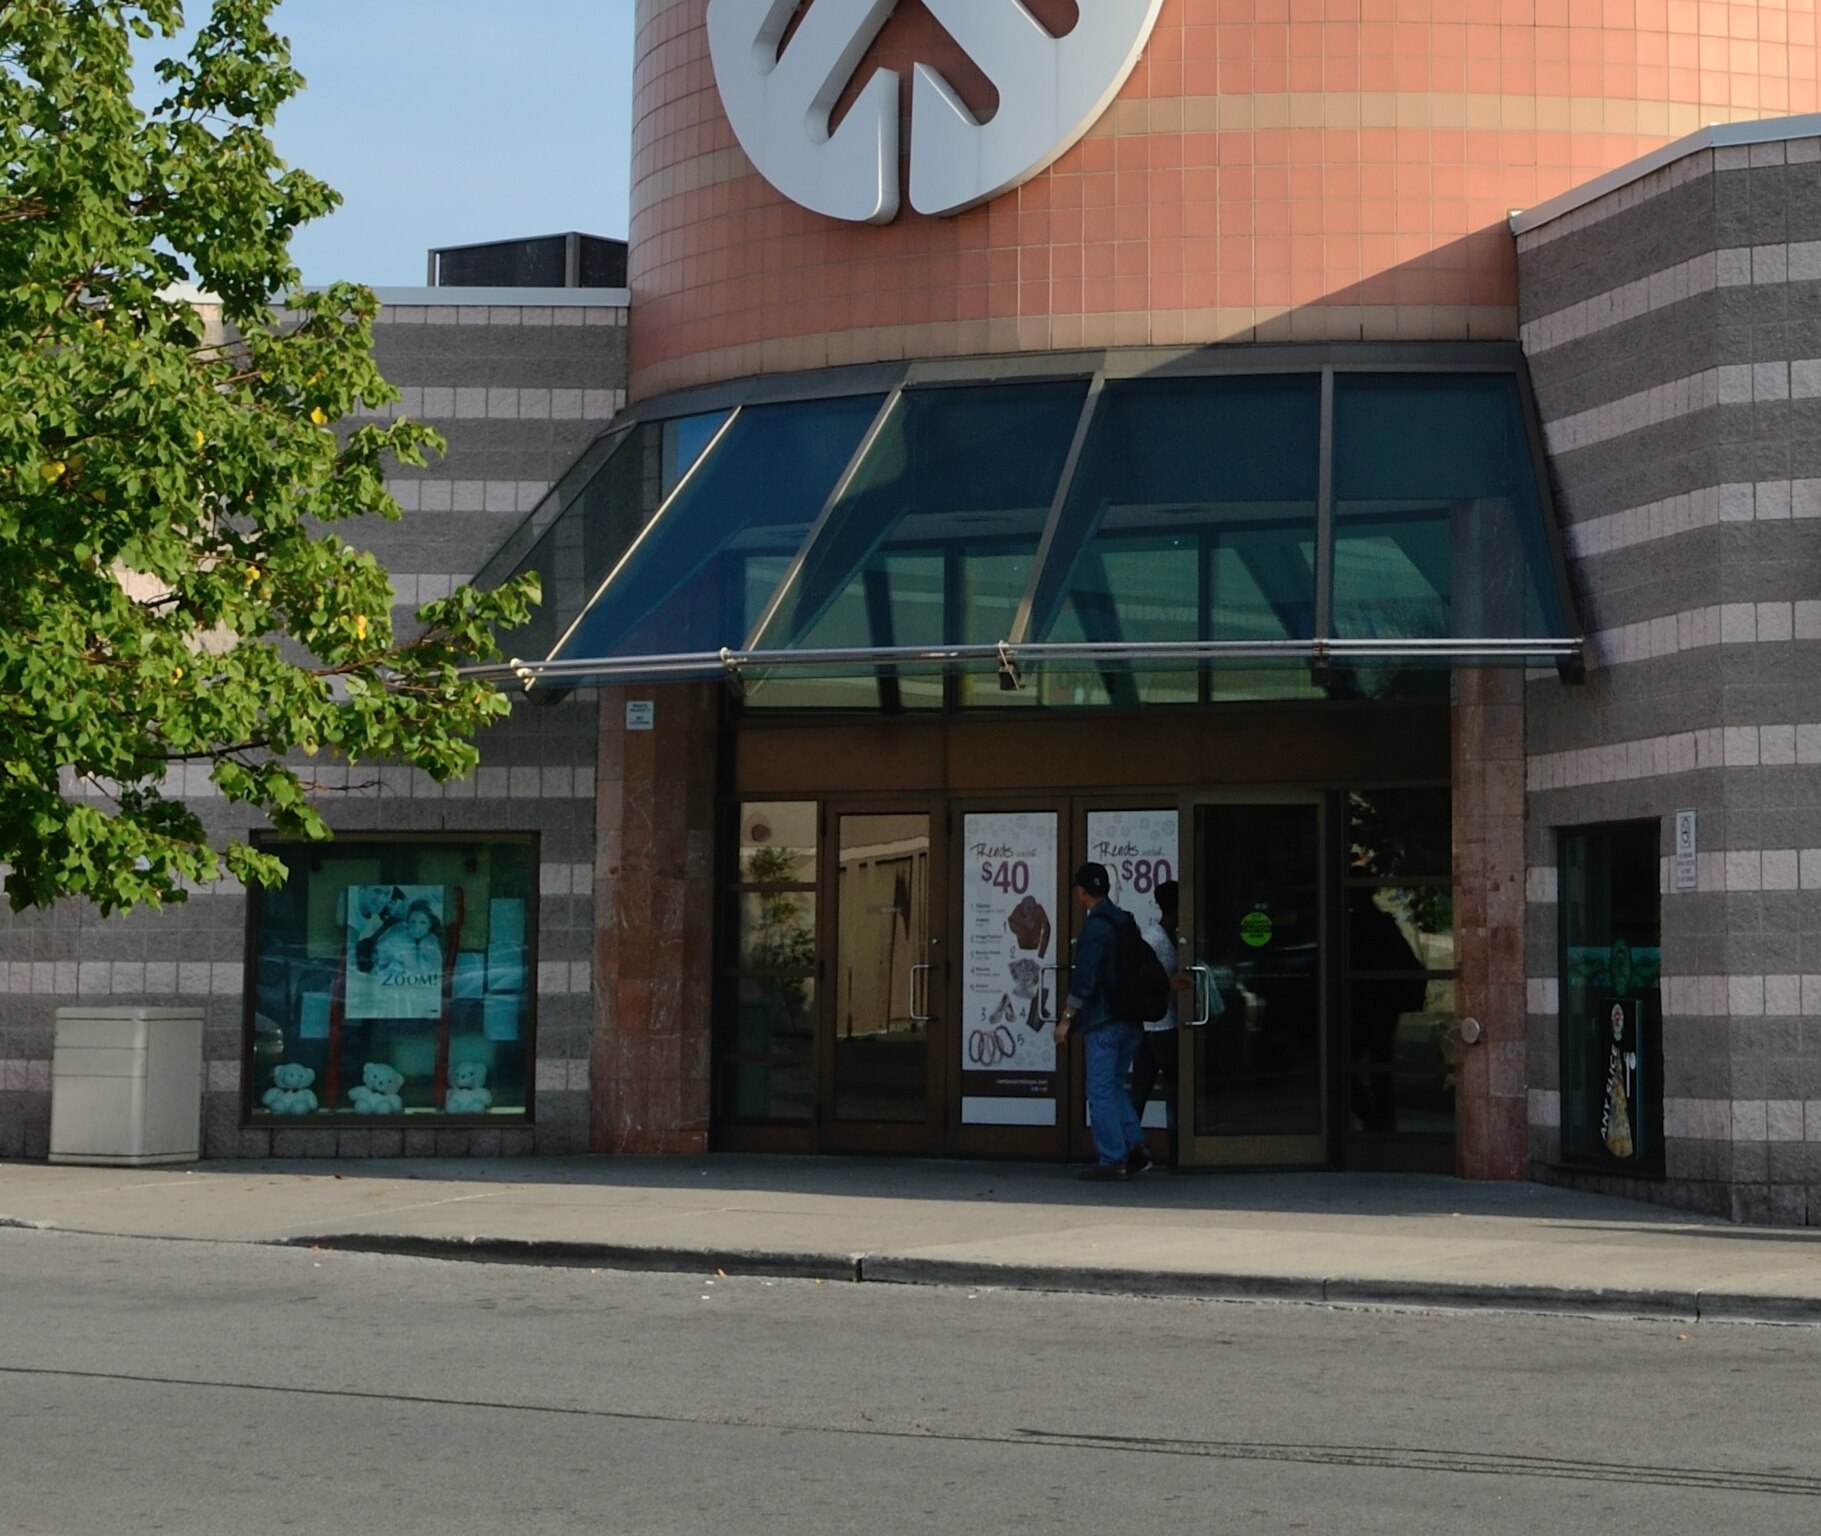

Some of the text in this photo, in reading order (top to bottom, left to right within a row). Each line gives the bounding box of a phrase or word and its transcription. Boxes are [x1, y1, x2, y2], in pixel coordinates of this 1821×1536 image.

[981, 860, 1029, 894] $40
[1122, 859, 1171, 894] $80
[381, 973, 438, 986] ZOOM!
